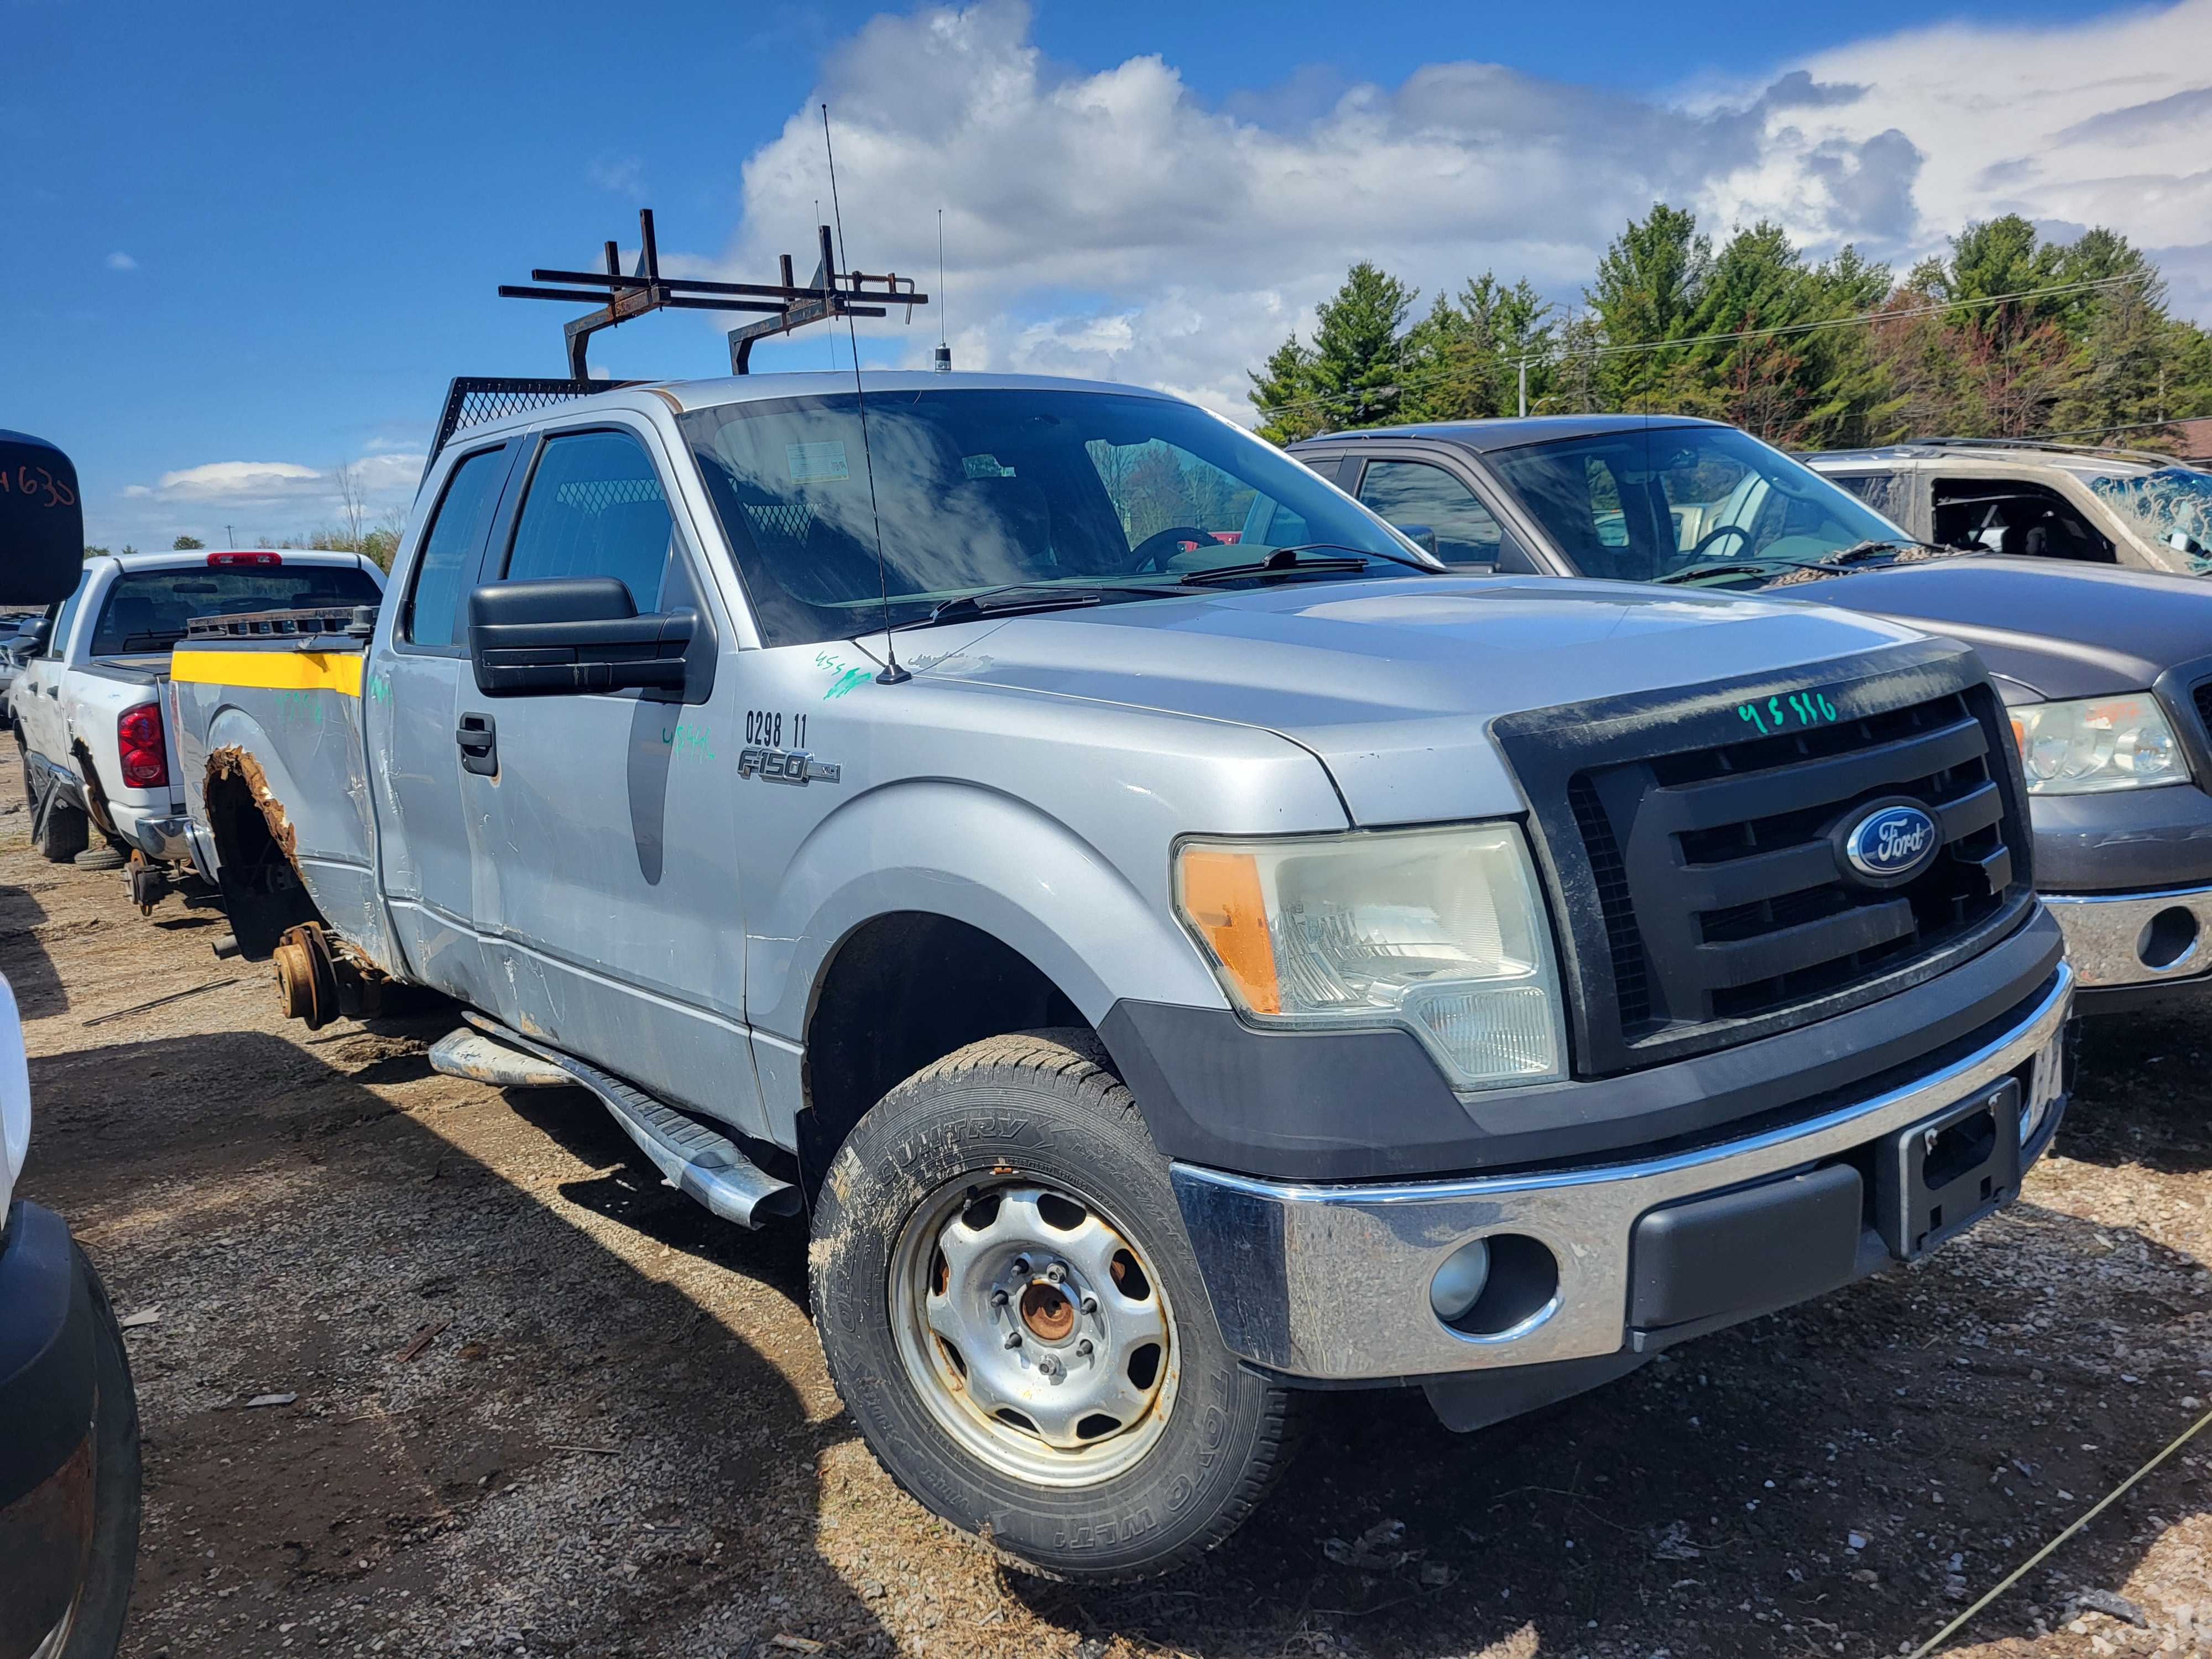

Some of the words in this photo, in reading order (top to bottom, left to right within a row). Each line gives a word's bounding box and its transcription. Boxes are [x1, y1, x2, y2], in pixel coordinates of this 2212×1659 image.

[746, 710, 781, 747] 0298
[794, 713, 807, 749] 11
[1877, 818, 1923, 862] Ford
[1163, 1367, 1231, 1512] TOYO
